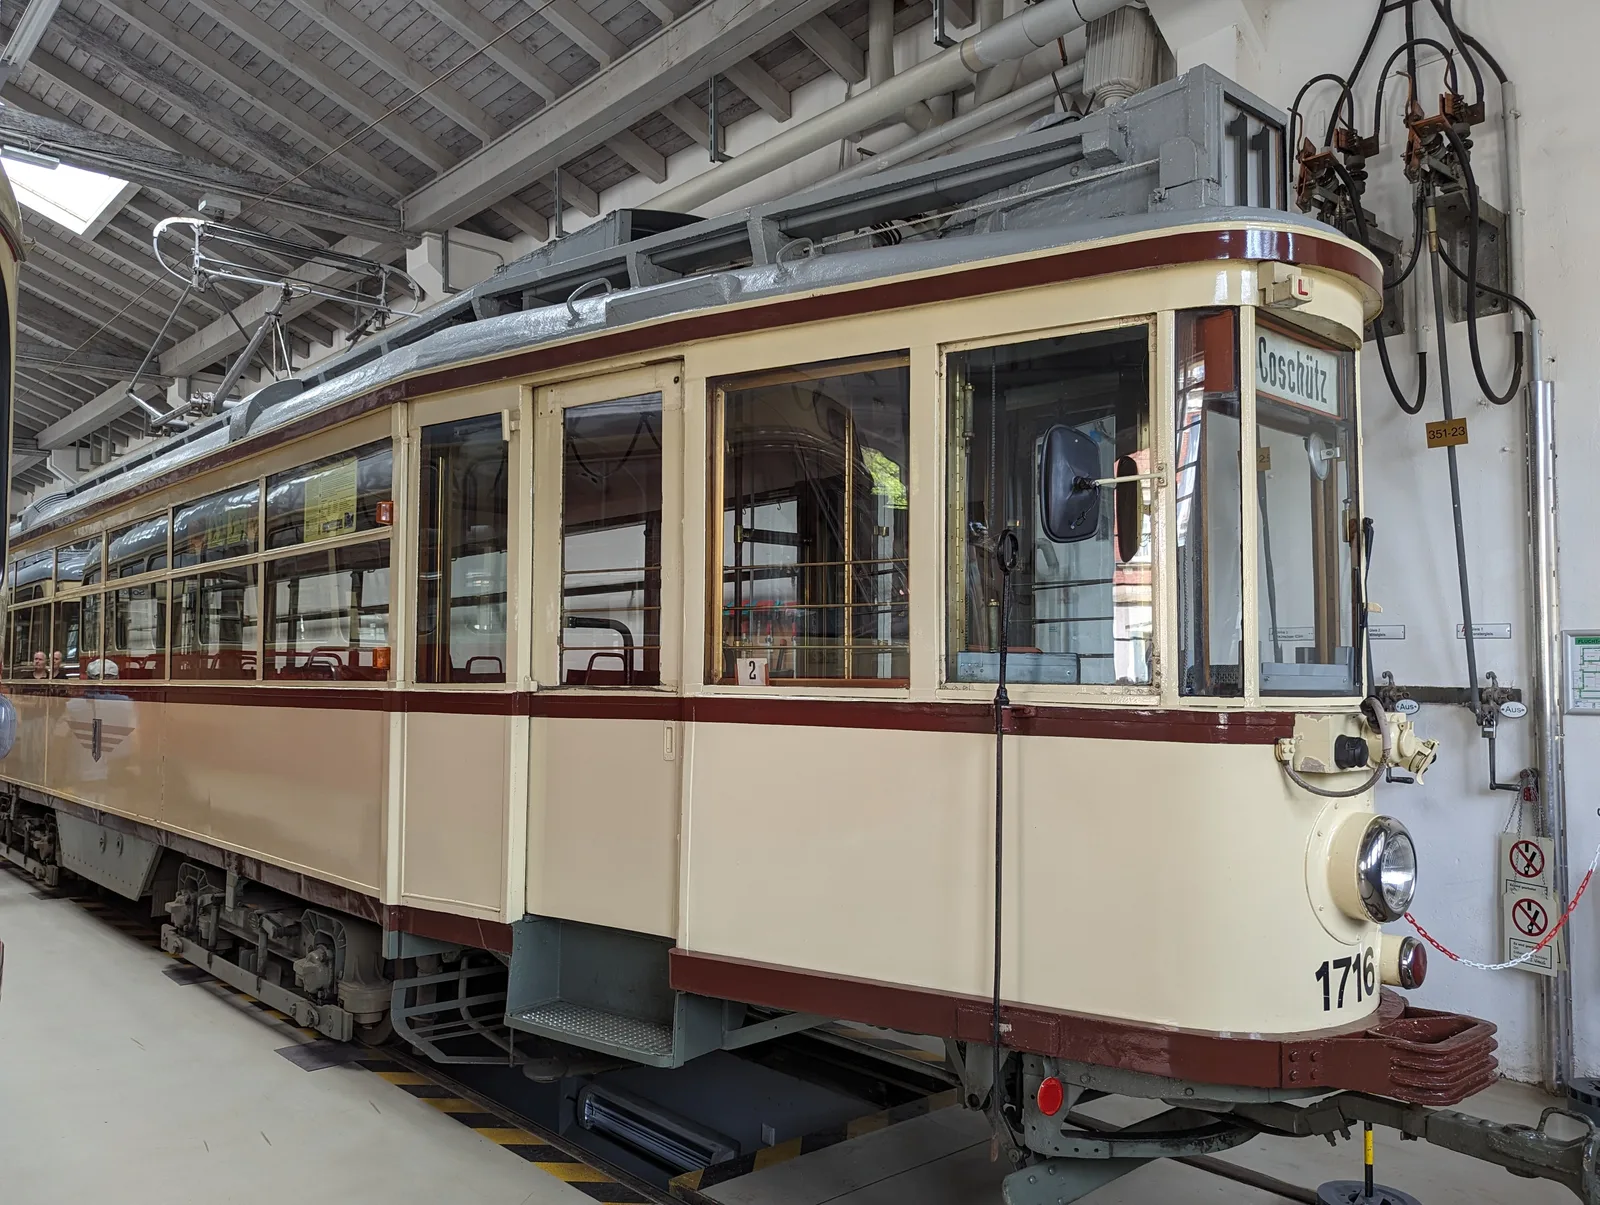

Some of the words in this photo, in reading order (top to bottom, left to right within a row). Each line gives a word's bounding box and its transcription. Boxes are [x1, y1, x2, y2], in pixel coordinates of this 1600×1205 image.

[1298, 279, 1309, 296] L
[1258, 336, 1327, 404] Coschütz
[1428, 426, 1466, 440] 351-23
[748, 660, 757, 680] 2
[1400, 703, 1415, 711] Aus
[1504, 705, 1522, 713] Aus
[1315, 946, 1375, 1012] 1716
